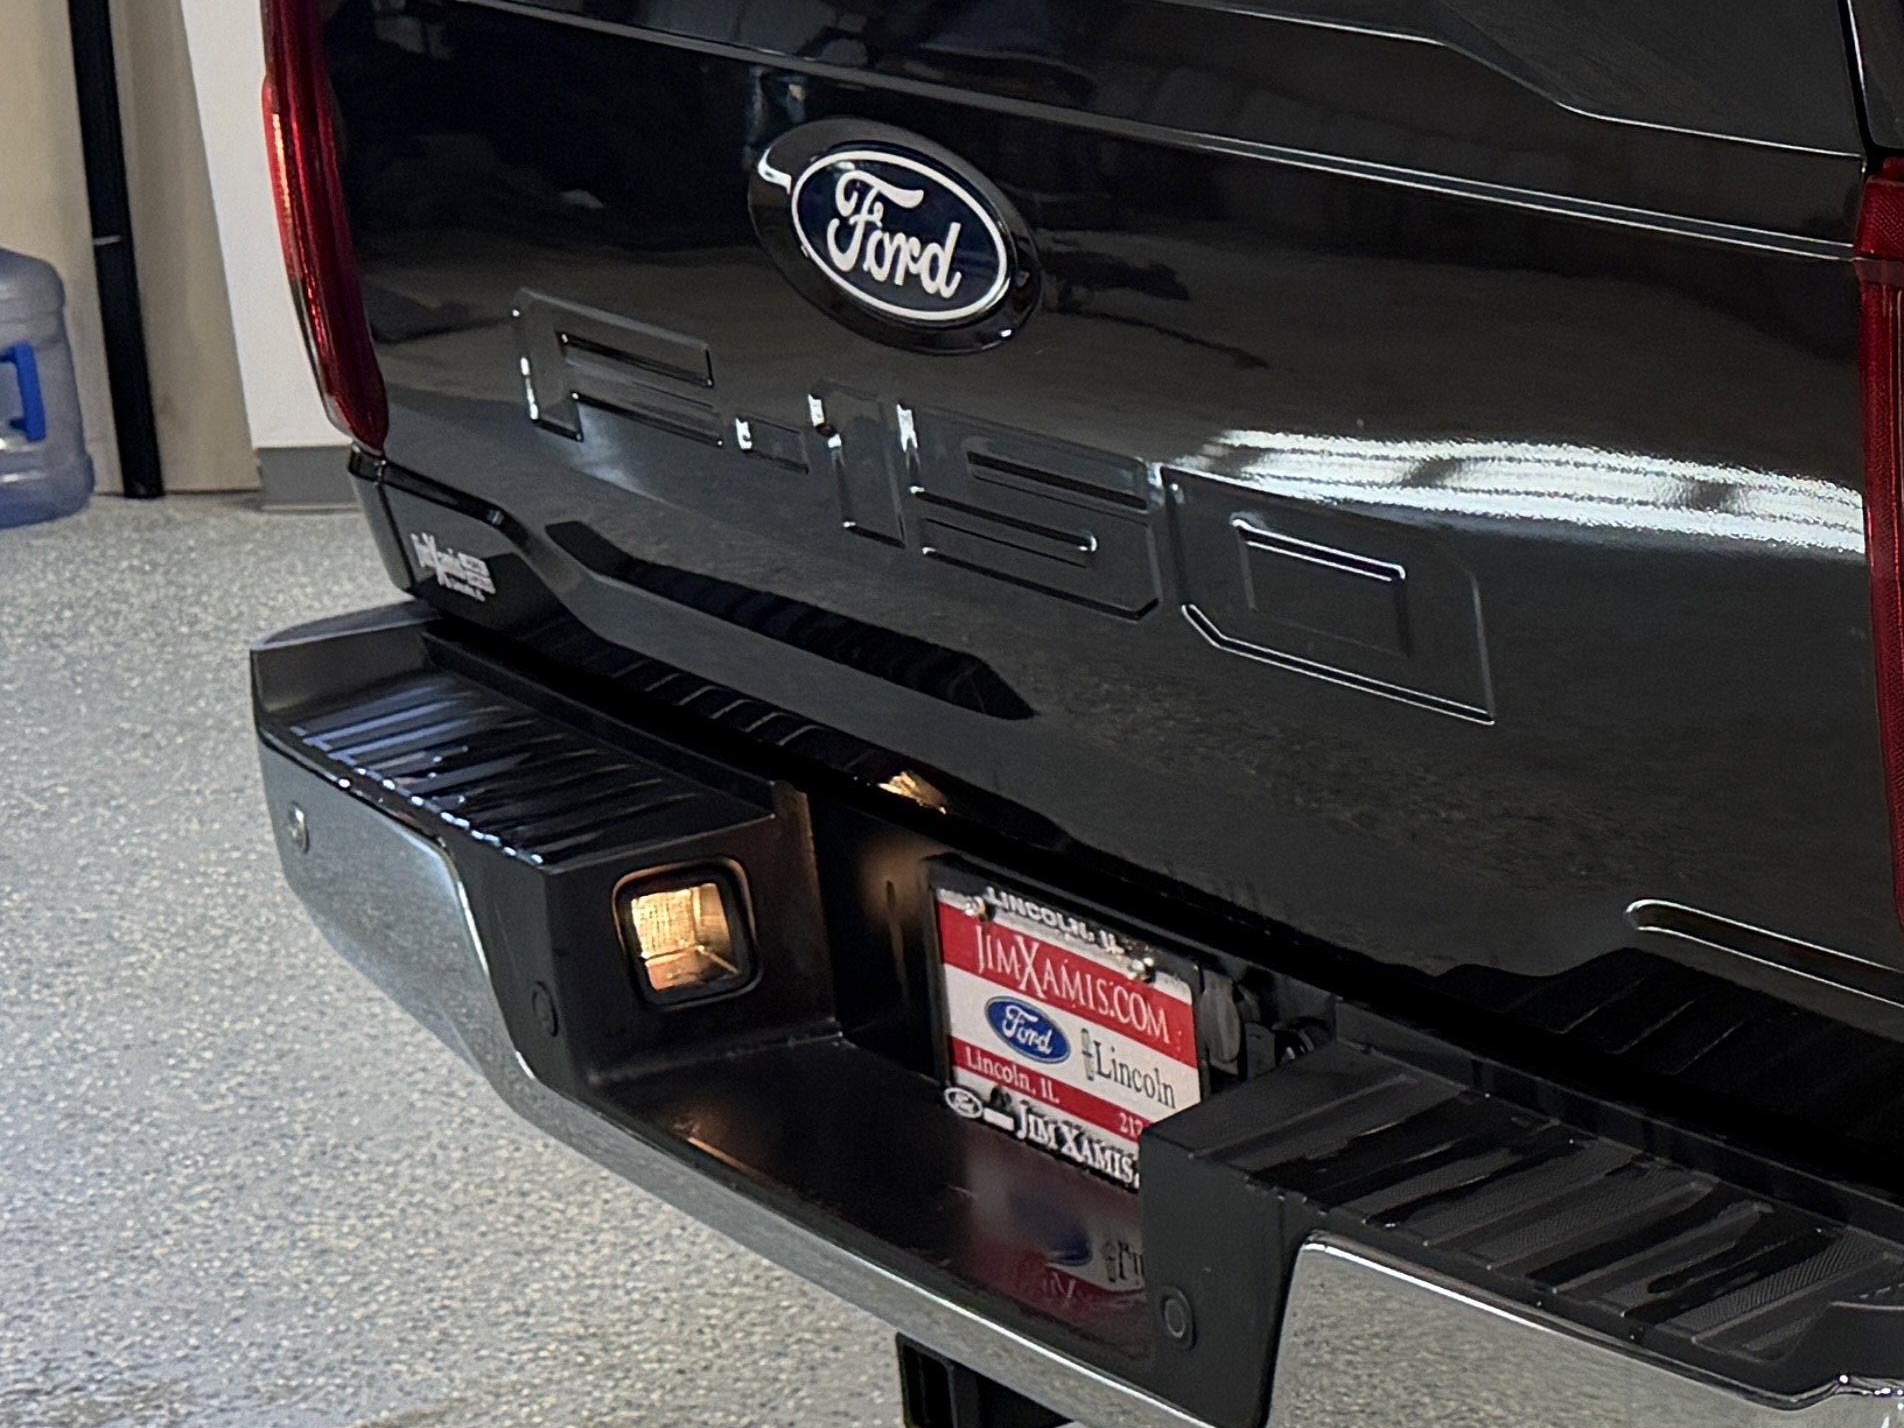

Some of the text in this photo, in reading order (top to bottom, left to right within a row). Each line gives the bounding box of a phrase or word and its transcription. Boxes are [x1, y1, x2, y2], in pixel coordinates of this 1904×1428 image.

[826, 170, 962, 299] Ford
[1001, 1004, 1054, 1056] Ford
[965, 1046, 1037, 1095] Lincoln,
[1092, 1040, 1177, 1110] Lincoln
